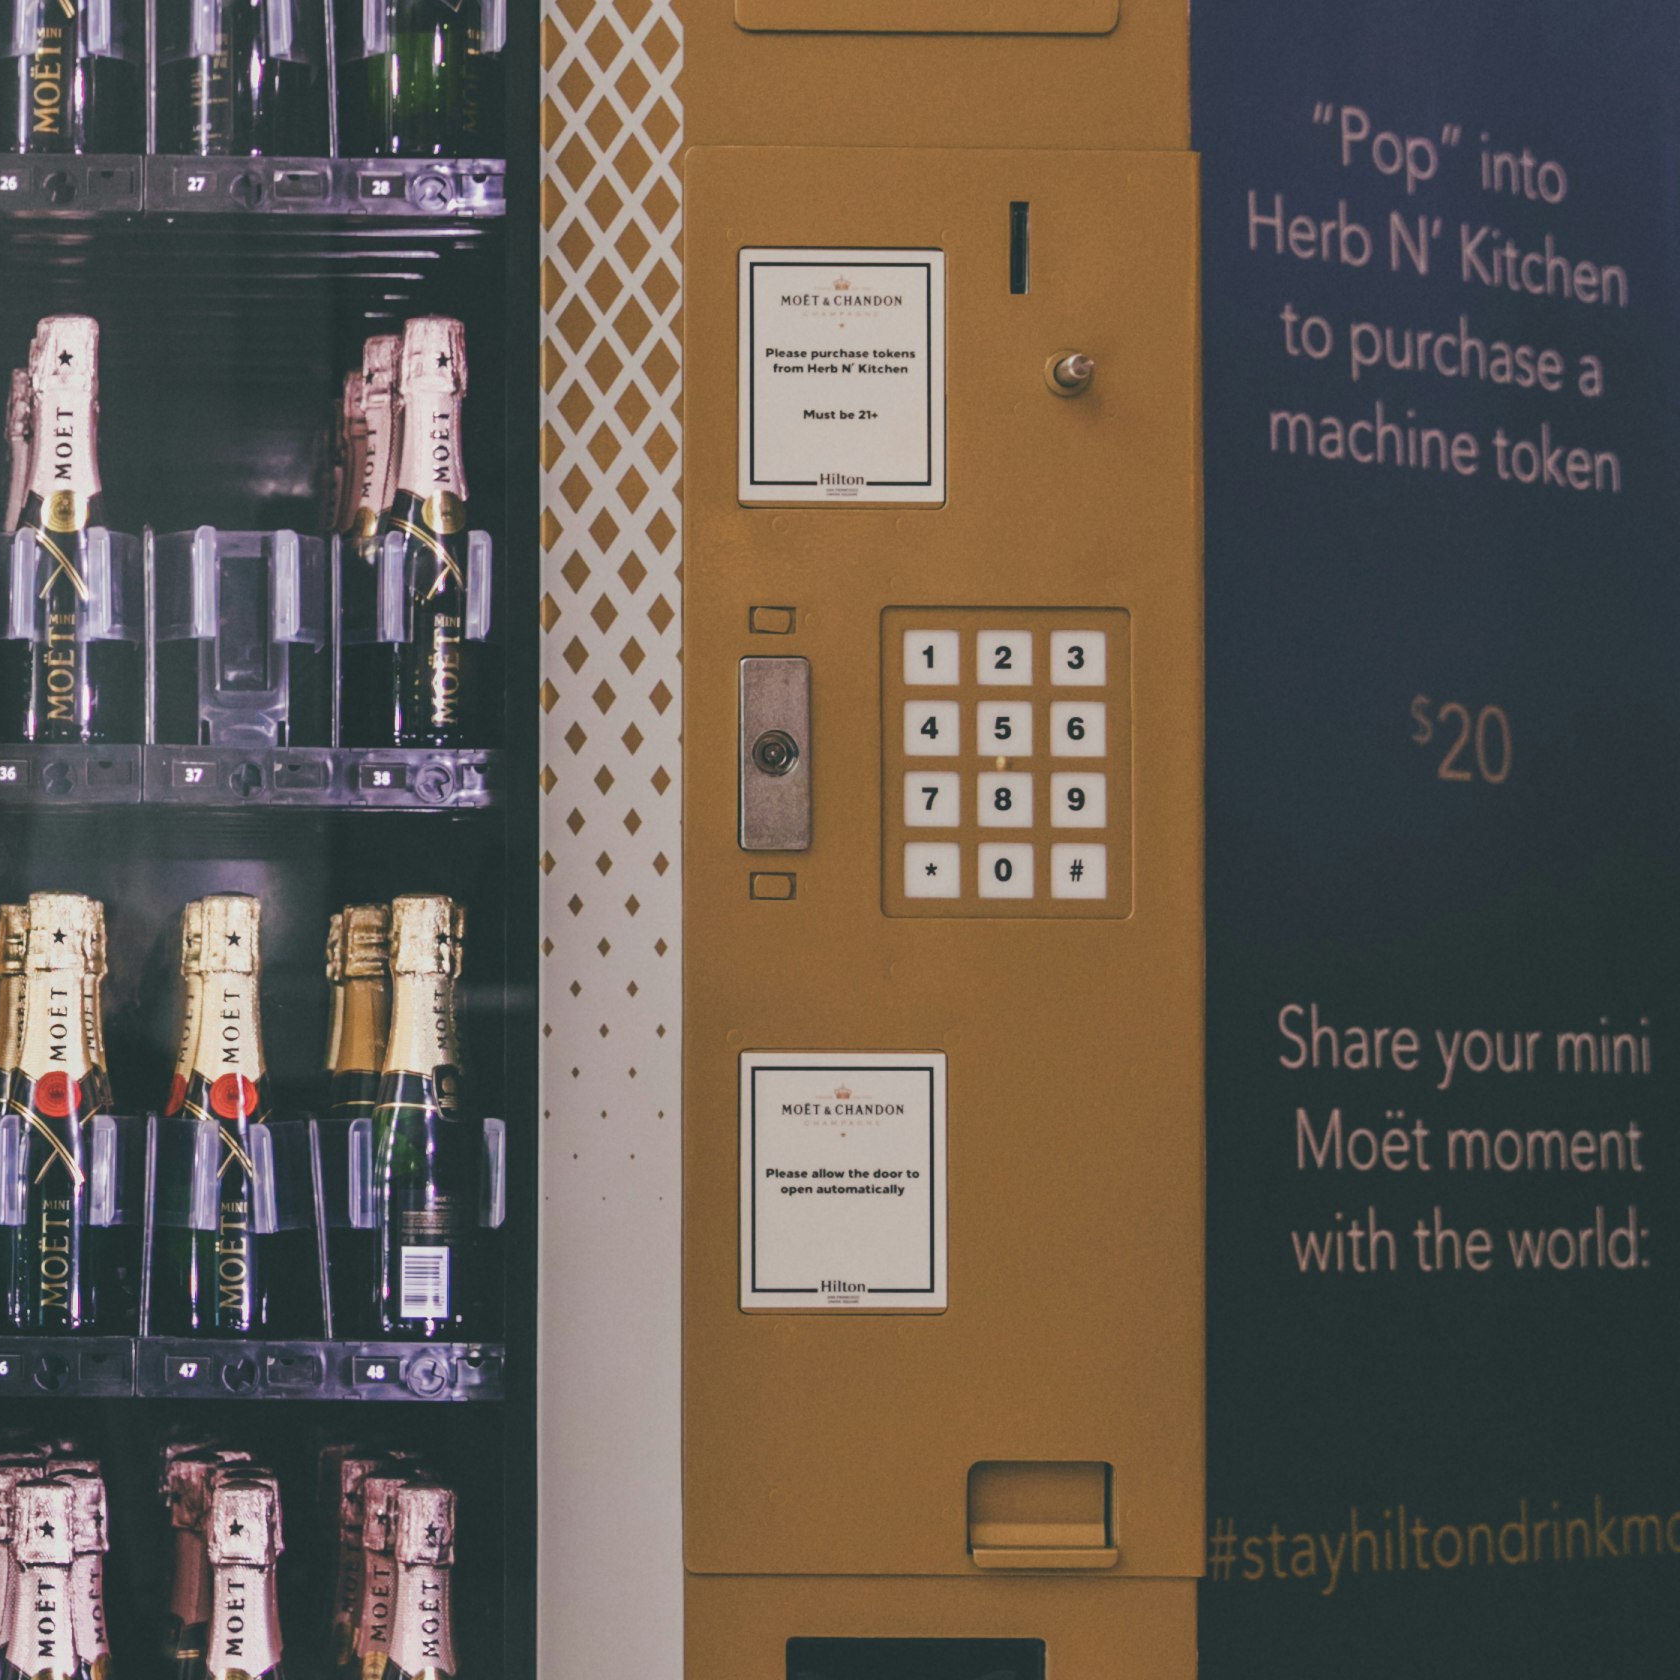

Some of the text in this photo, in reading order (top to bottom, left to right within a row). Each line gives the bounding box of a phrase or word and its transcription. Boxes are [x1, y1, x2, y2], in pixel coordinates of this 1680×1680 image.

[29, 43, 61, 134] MOËT
[1479, 132, 1569, 204] into
[0, 176, 17, 191] 26
[188, 177, 204, 192] 27
[372, 180, 390, 195] 28
[1247, 189, 1629, 307] Herb N' Kitchen
[780, 294, 903, 306] MOËT & CHANDON
[765, 348, 915, 361] Please purchase tokens
[1280, 302, 1603, 398] to purchase a
[773, 364, 804, 374] from
[807, 364, 838, 373] Herb
[858, 364, 908, 374] Kitchen
[803, 410, 878, 420] Must be 21+
[1269, 400, 1622, 493] machine token
[820, 473, 865, 486] Hilton
[48, 613, 76, 625] MINI
[922, 645, 1085, 670] 1 2 3
[44, 626, 75, 721] MOËT
[920, 716, 1085, 740] 4 5 6
[1410, 694, 1512, 785] $20
[185, 768, 202, 783] 37
[373, 771, 390, 786] 38
[921, 787, 1085, 811] 7 8 9
[994, 858, 1084, 882] 0 #
[1278, 1002, 1652, 1091] Share your mini
[781, 1103, 904, 1115] MOËT & CHANDON
[1296, 1107, 1645, 1172] Moët moment
[766, 1168, 920, 1179] Please allow the door to
[780, 1185, 905, 1196] open automatically
[42, 1199, 71, 1211] MINI
[1291, 1204, 1651, 1272] with the world:
[38, 1213, 69, 1310] MOËT
[215, 1215, 247, 1311] MOËT
[821, 1280, 865, 1292] Hilton
[179, 1363, 197, 1378] 47
[367, 1365, 385, 1381] 48
[35, 1579, 54, 1657] MOËT
